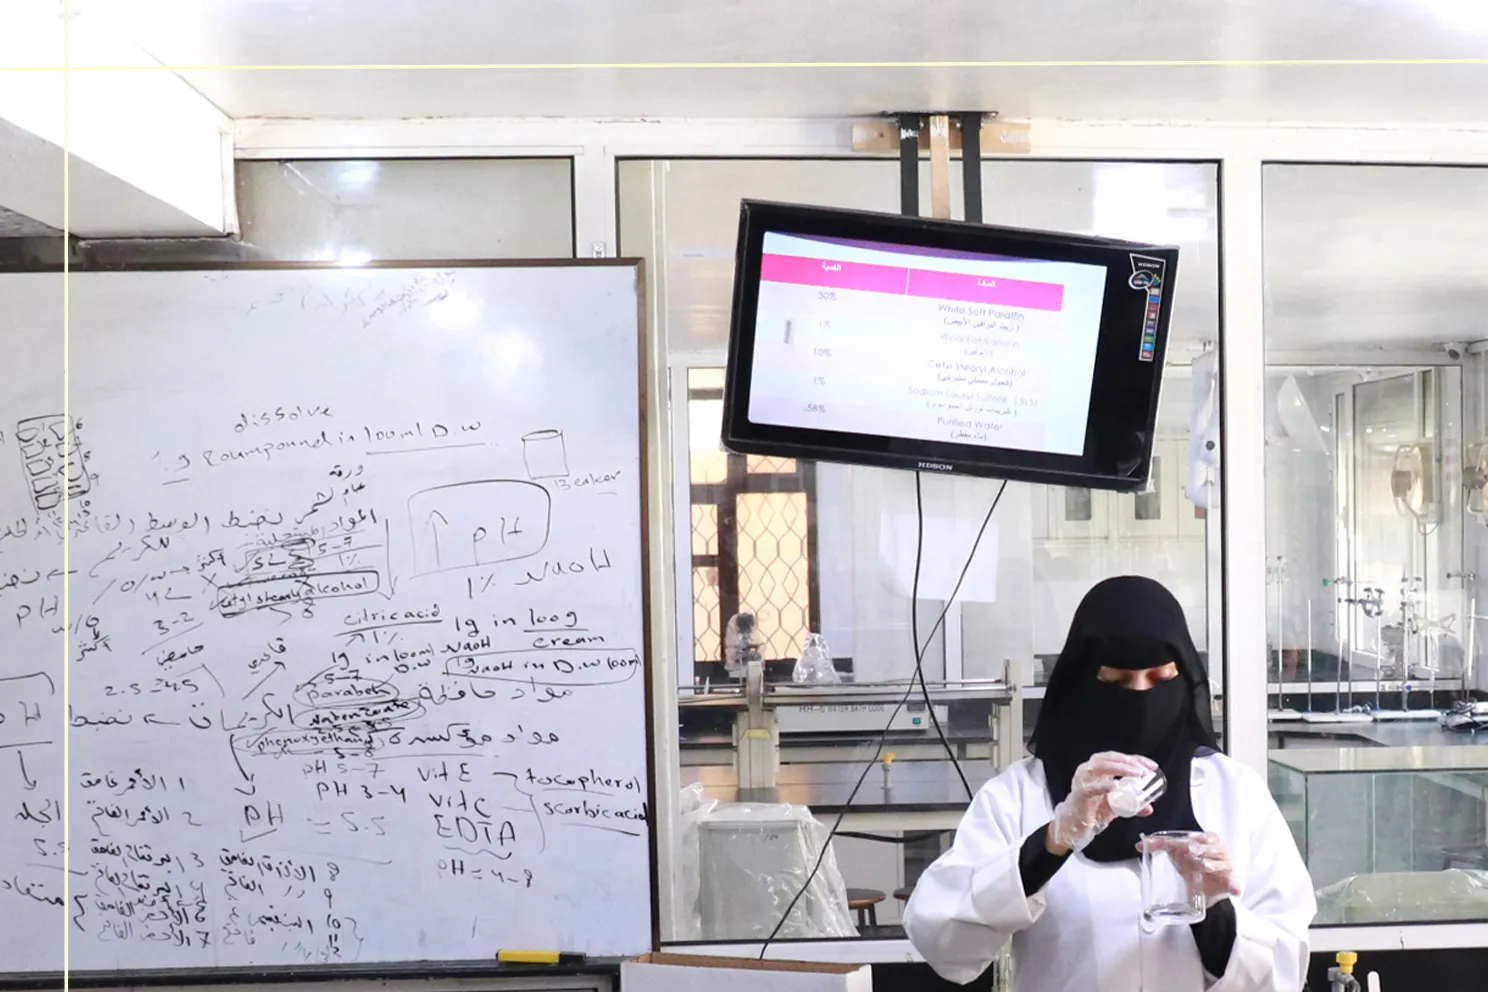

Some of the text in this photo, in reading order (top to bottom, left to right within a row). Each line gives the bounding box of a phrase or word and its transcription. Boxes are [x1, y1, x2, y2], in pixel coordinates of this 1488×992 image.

[818, 291, 837, 301] 30%
[938, 303, 965, 315] White
[968, 306, 986, 317] Soft
[989, 366, 1027, 378] Alcohol
[234, 404, 335, 435] dissolve
[937, 416, 1003, 432] Purified Water
[467, 573, 497, 600] 1%
[343, 602, 442, 626] citric acid
[492, 613, 518, 629] in
[532, 634, 606, 650] cream
[433, 812, 517, 847] EDTA
